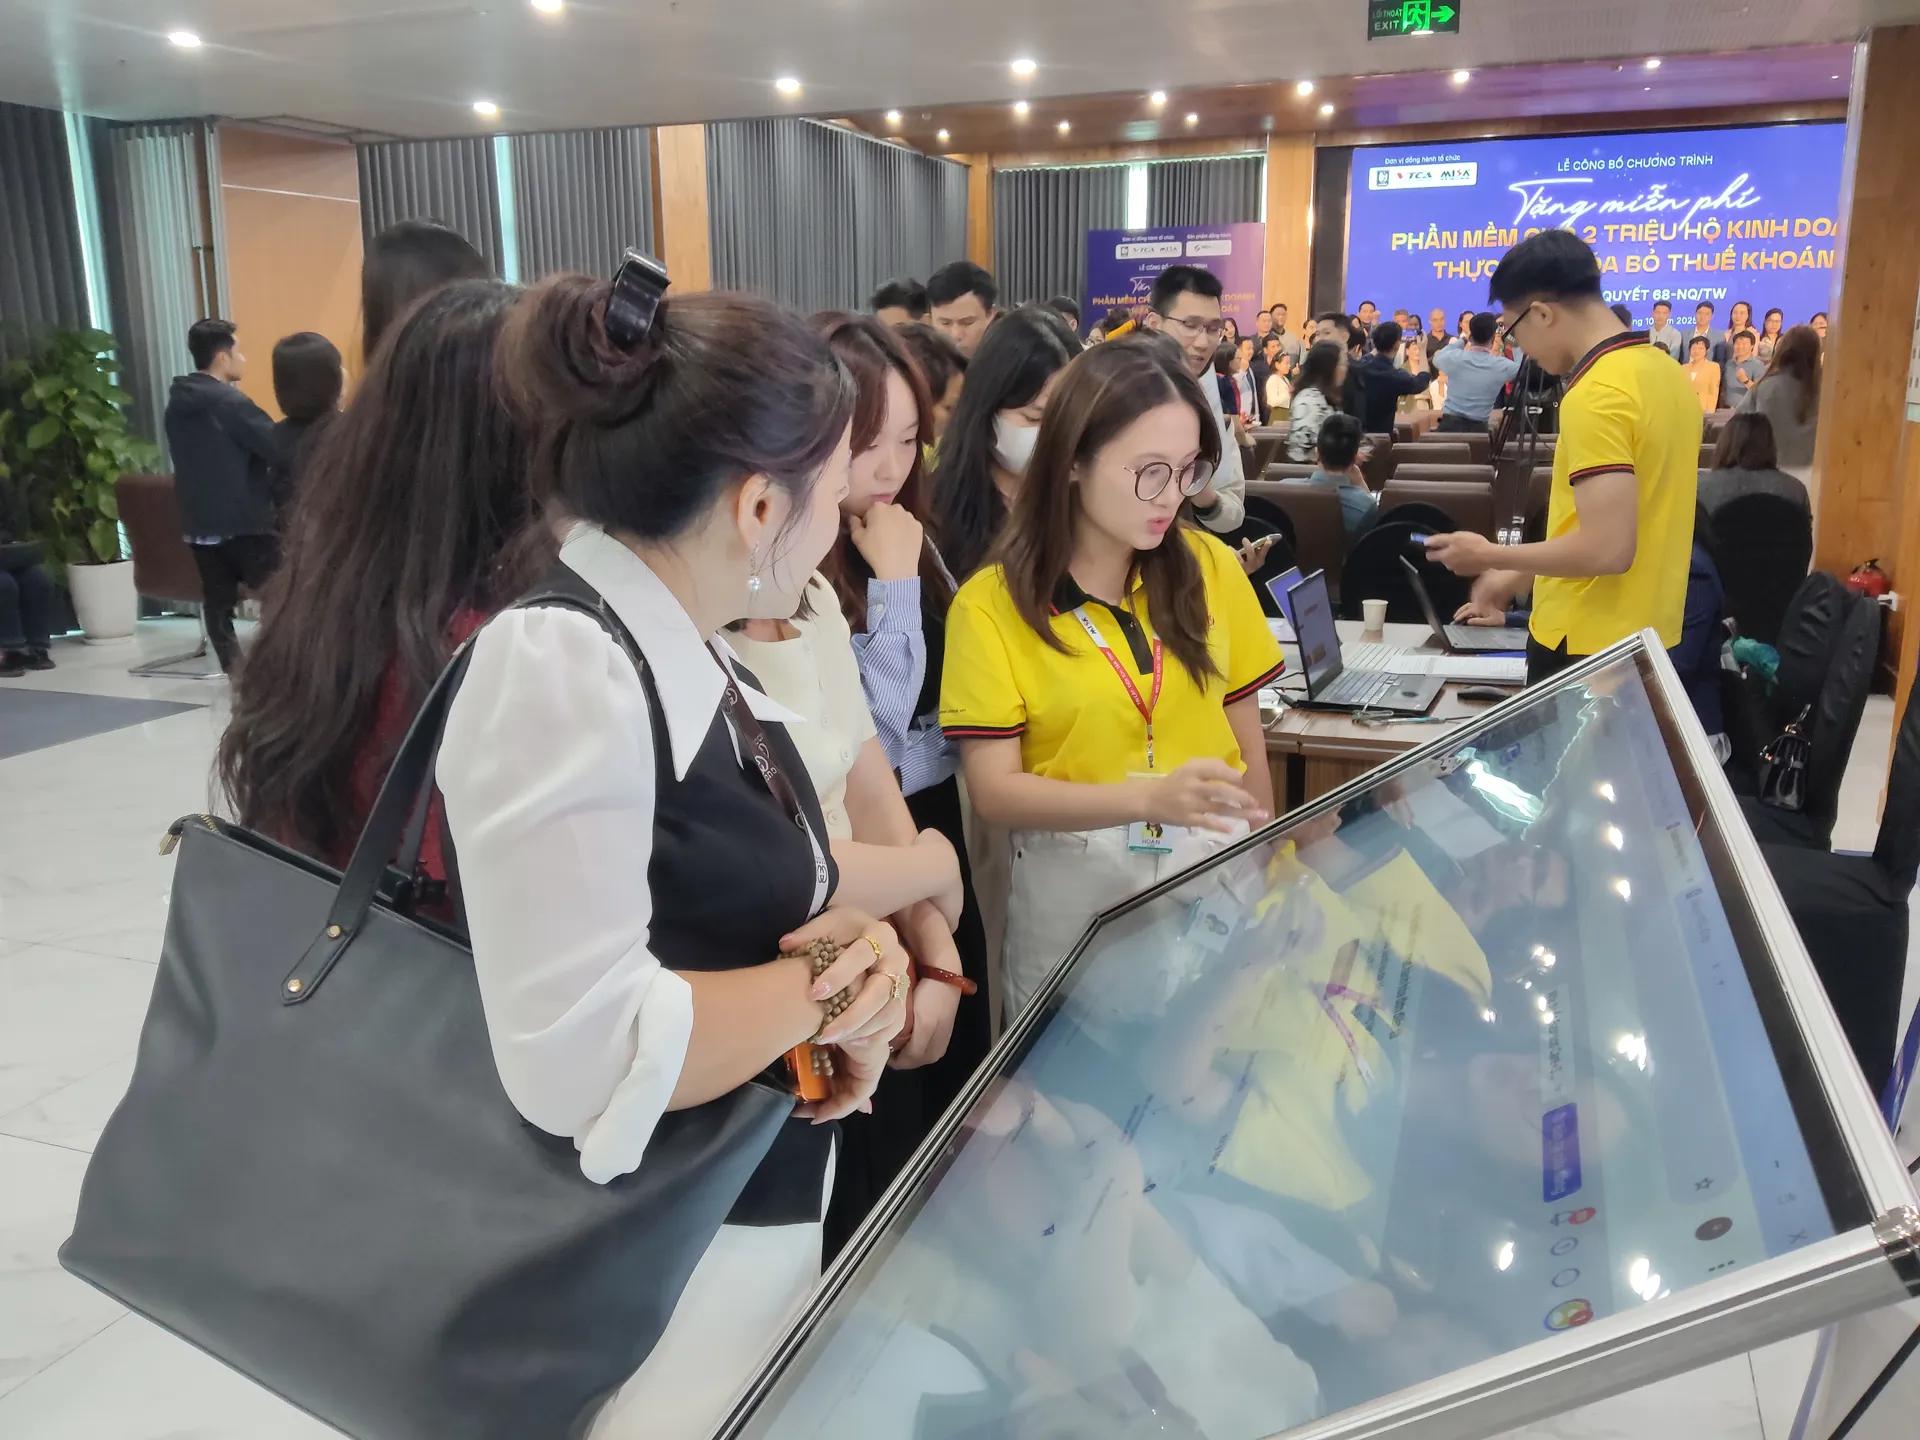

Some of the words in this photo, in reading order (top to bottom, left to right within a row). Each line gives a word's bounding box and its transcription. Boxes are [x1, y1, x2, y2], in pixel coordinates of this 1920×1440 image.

[1374, 20, 1400, 31] EXIT
[1557, 157, 1570, 172] LỄ
[1573, 157, 1605, 171] CÔNG
[1608, 155, 1624, 169] BỐ
[1626, 152, 1676, 168] CHƯƠNG
[1679, 153, 1713, 167] TRÌNH
[1440, 169, 1471, 178] MISA
[1508, 177, 1598, 230] Tặng
[1599, 183, 1691, 213] miễn
[1678, 172, 1762, 231] phí
[1391, 222, 1458, 251] PHẦN
[1462, 221, 1518, 248] MỀM
[1583, 225, 1597, 243] 2
[1603, 218, 1678, 246] TRIỆU
[1683, 216, 1722, 245] HỘ
[1726, 218, 1789, 240] KINH
[1625, 248, 1660, 273] BỎ
[1667, 243, 1737, 272] THUẾ
[1741, 245, 1836, 271] KHOÁN
[1602, 285, 1650, 302] QUYẾT
[1652, 287, 1727, 301] 68-NQ/TW
